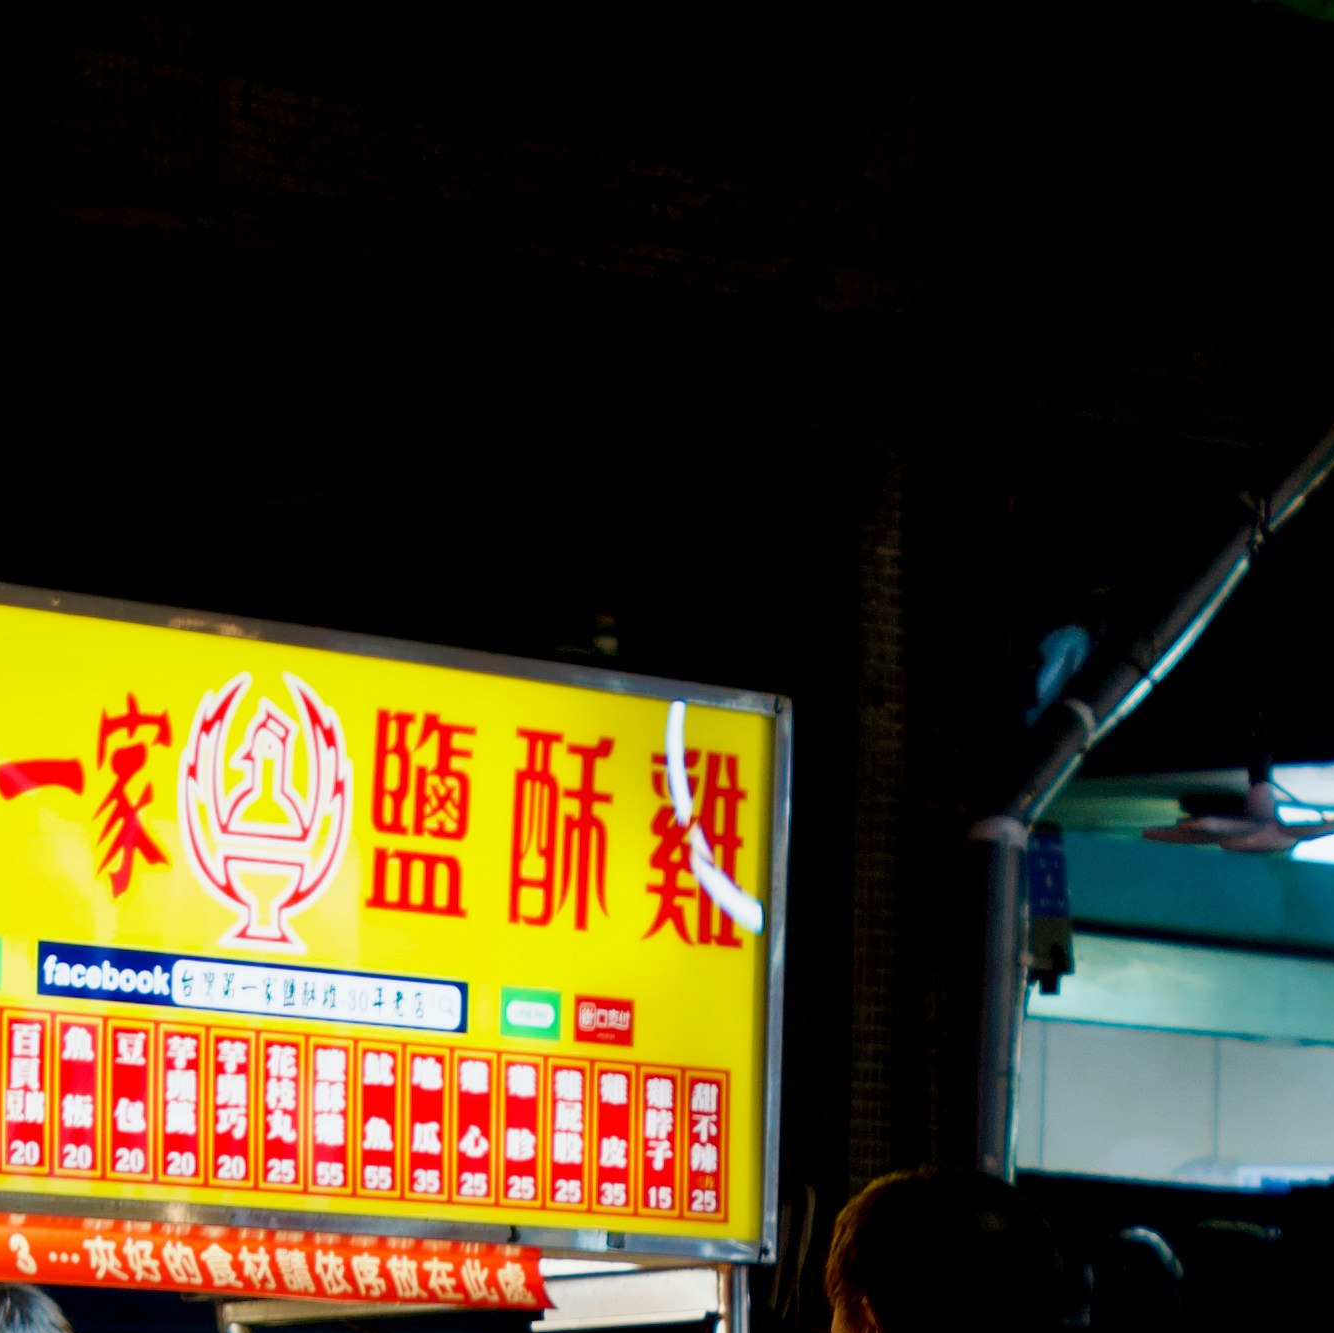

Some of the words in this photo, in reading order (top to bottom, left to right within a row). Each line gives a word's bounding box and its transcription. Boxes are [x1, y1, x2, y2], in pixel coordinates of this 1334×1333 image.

[364, 708, 747, 949] 鹽酥雞
[43, 954, 170, 995] facebook
[9, 1139, 40, 1166] 20
[62, 1143, 93, 1170] 20
[115, 1147, 145, 1173] 20
[166, 1151, 196, 1177] 20
[217, 1154, 246, 1180] 20
[267, 1158, 296, 1184] 25
[315, 1161, 344, 1187] 55
[364, 1165, 392, 1190] 55
[413, 1168, 440, 1194] 35
[460, 1172, 488, 1198] 25
[507, 1175, 535, 1200] 25
[555, 1179, 582, 1203] 25
[600, 1182, 626, 1206] 35
[648, 1186, 672, 1209] 15
[691, 1189, 717, 1212] 25
